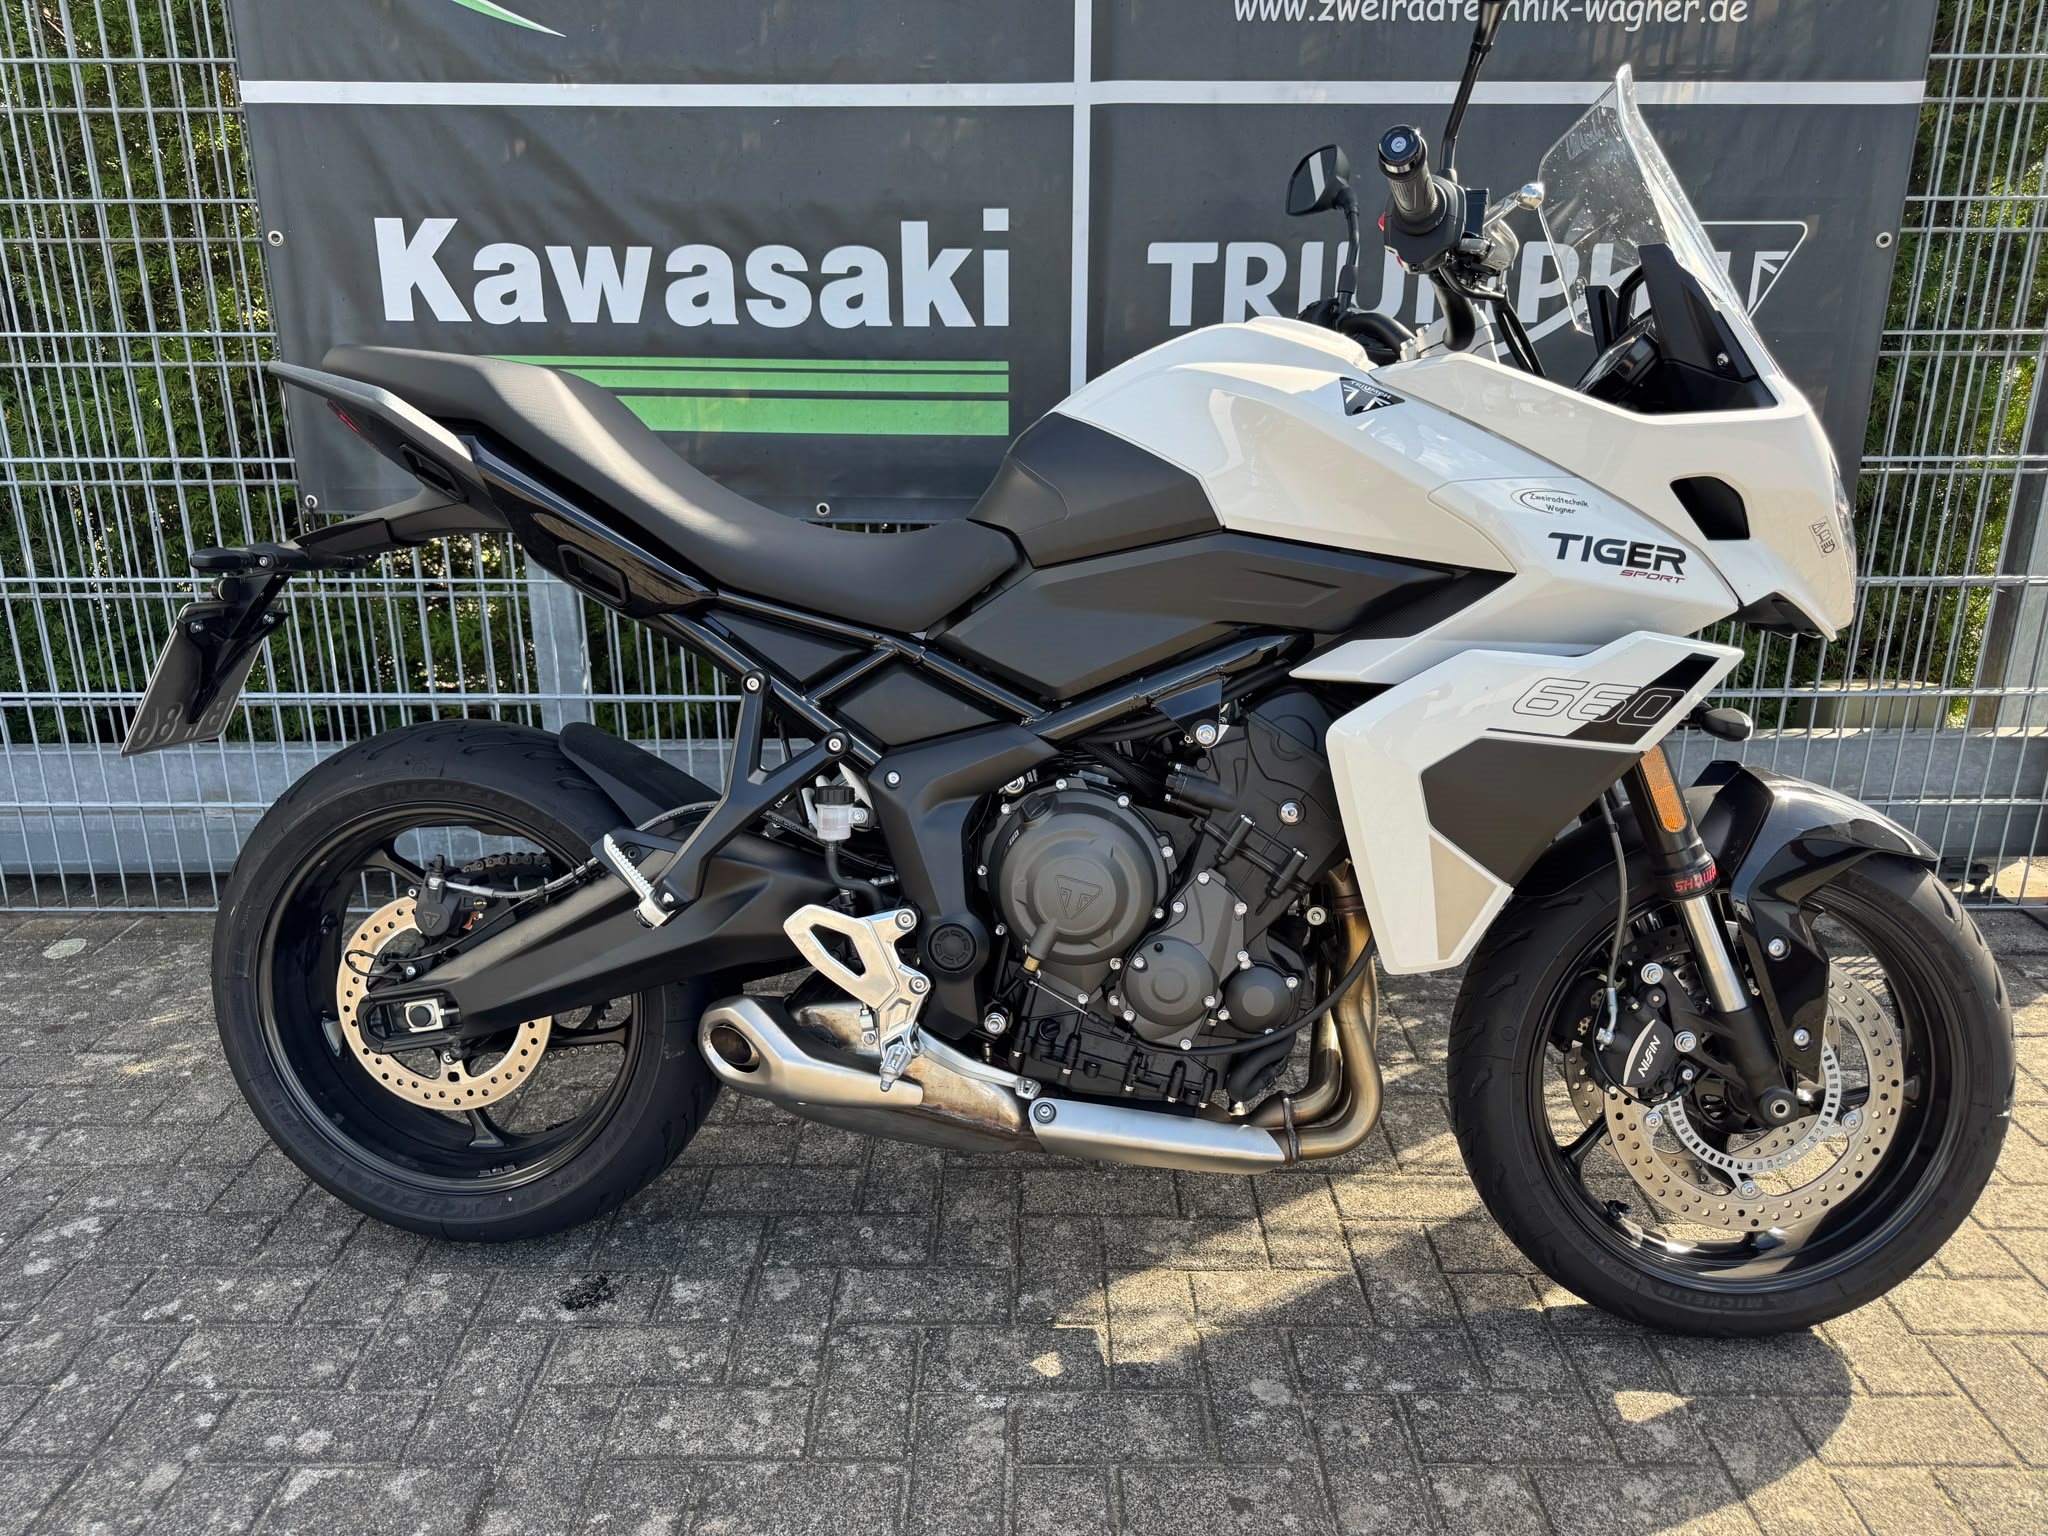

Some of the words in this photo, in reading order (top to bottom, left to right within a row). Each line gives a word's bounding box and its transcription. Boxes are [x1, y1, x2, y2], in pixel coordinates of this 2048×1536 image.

[373, 207, 1010, 329] Kawasaki
[1147, 241, 1655, 326] TRIUPH
[1350, 381, 1392, 400] TRIUMPH
[1529, 493, 1589, 508] Zweiradtechnik
[1545, 503, 1577, 515] Wagner
[1547, 531, 1688, 576] TIGER
[1618, 568, 1686, 585] SPORT
[1512, 677, 1687, 726] 660
[1637, 1034, 1661, 1078] NISSIN
